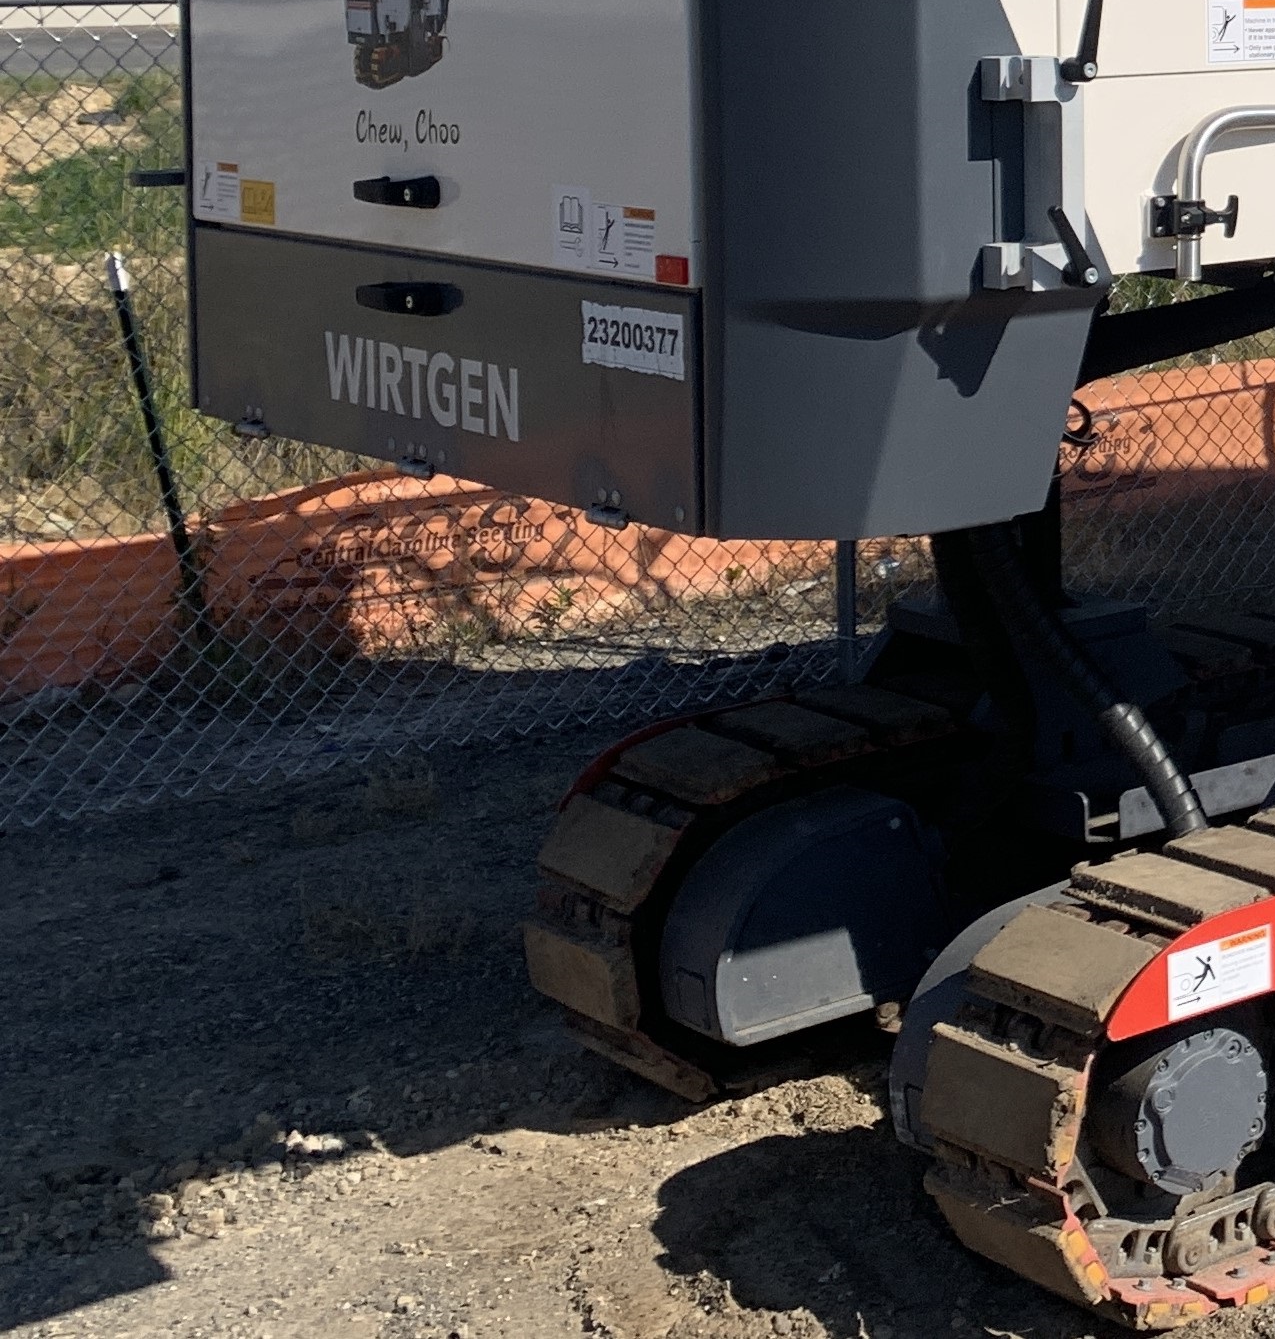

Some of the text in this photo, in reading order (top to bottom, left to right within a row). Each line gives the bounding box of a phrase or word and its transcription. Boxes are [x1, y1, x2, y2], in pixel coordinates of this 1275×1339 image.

[356, 110, 461, 152] Chew, Choo
[587, 316, 679, 357] 23200377
[324, 330, 520, 443] WIRTGEN
